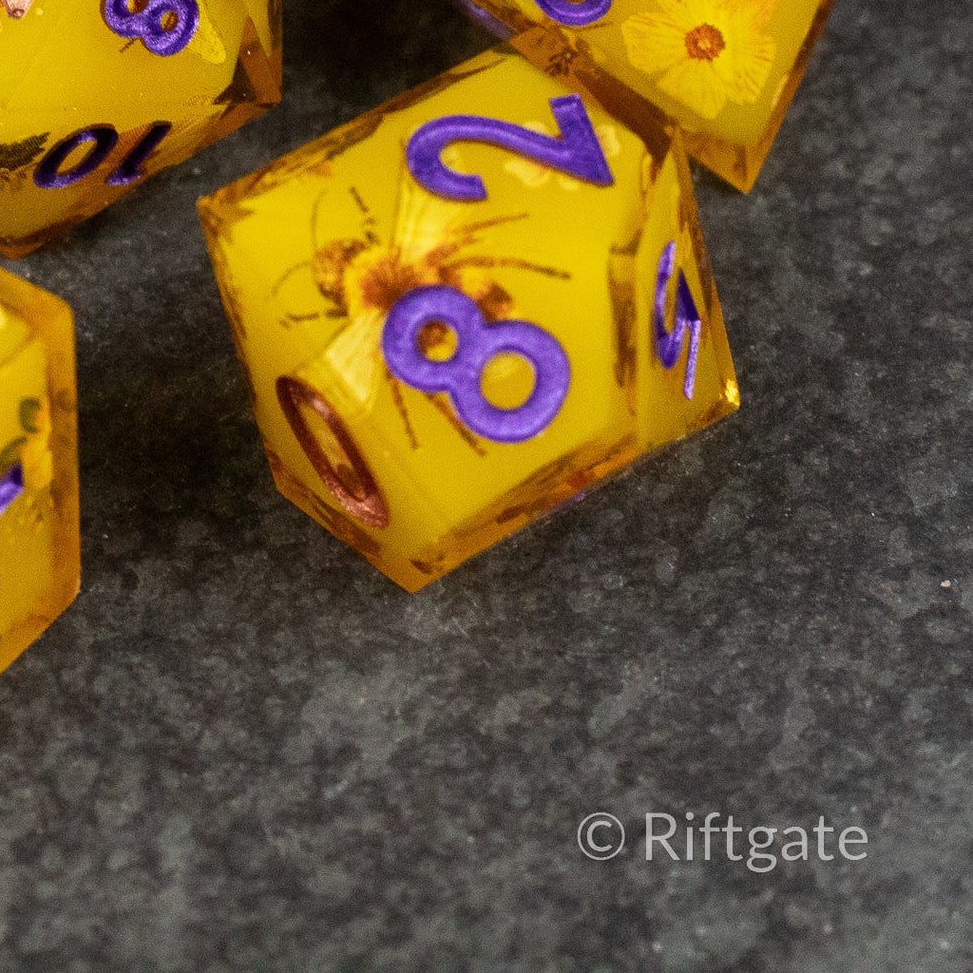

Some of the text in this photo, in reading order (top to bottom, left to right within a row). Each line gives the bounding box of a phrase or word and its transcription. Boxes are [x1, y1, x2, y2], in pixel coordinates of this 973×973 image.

[33, 121, 173, 189] 10
[405, 92, 613, 200] 2
[381, 285, 572, 444] 8
[275, 374, 390, 529] 0
